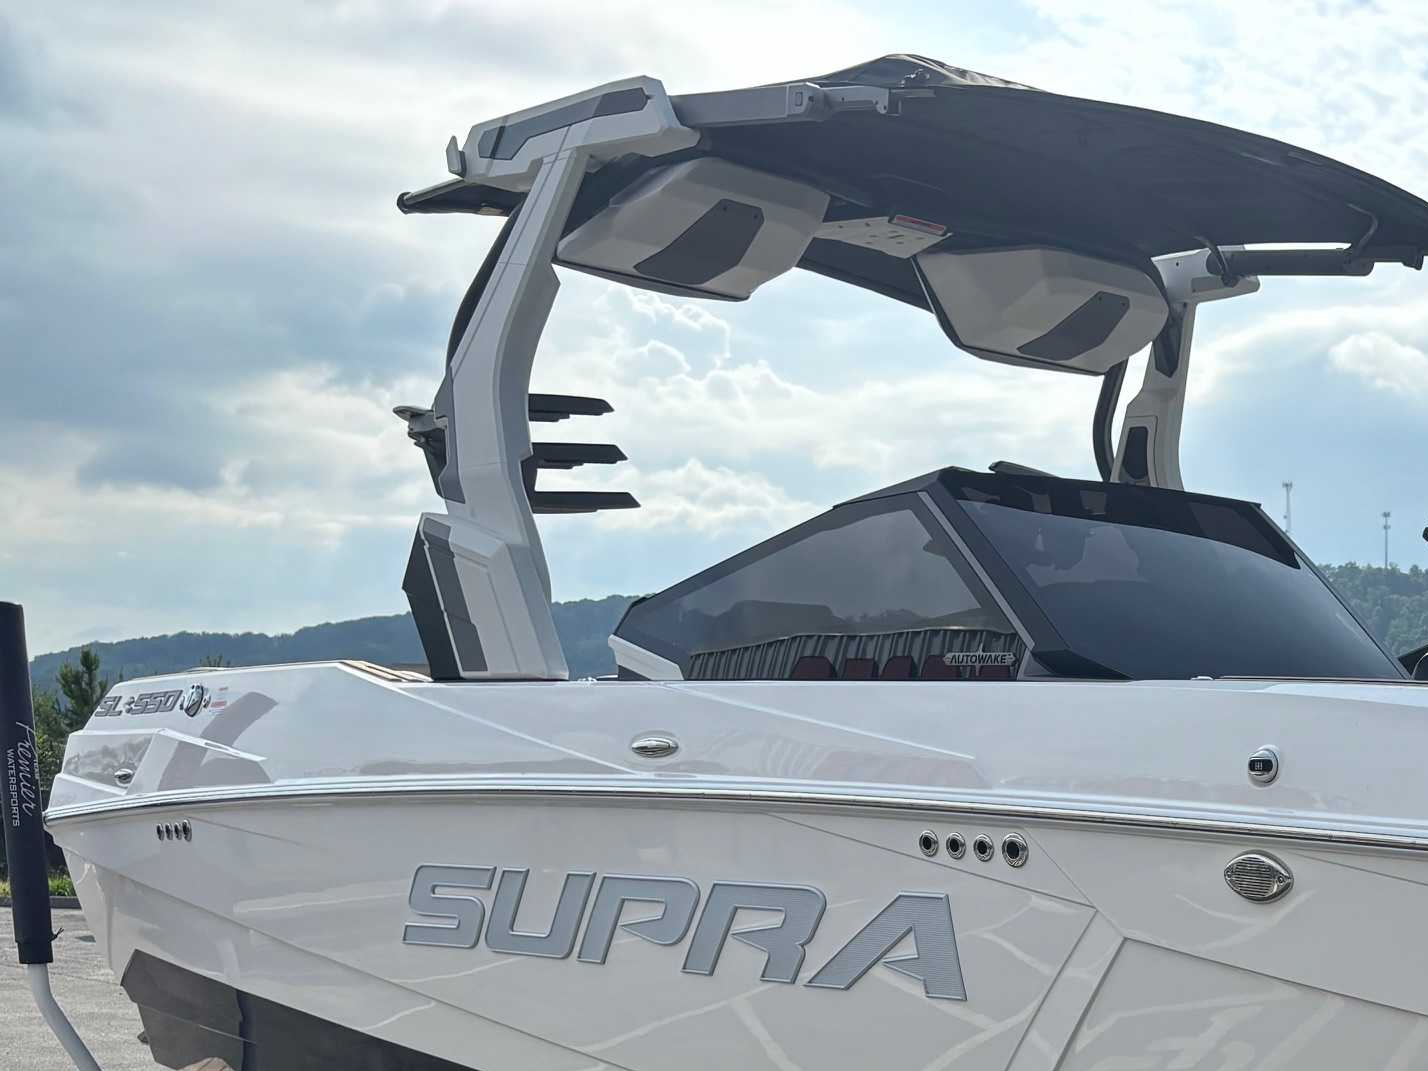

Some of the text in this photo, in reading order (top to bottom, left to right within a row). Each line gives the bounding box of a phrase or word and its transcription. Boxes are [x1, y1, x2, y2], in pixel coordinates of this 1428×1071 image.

[950, 653, 1008, 665] AUTOWAKE
[94, 695, 123, 717] SL
[130, 689, 183, 715] 550
[6, 747, 20, 827] WATERSPORTS
[15, 720, 39, 817] Premier
[402, 863, 967, 1001] SUPRA
